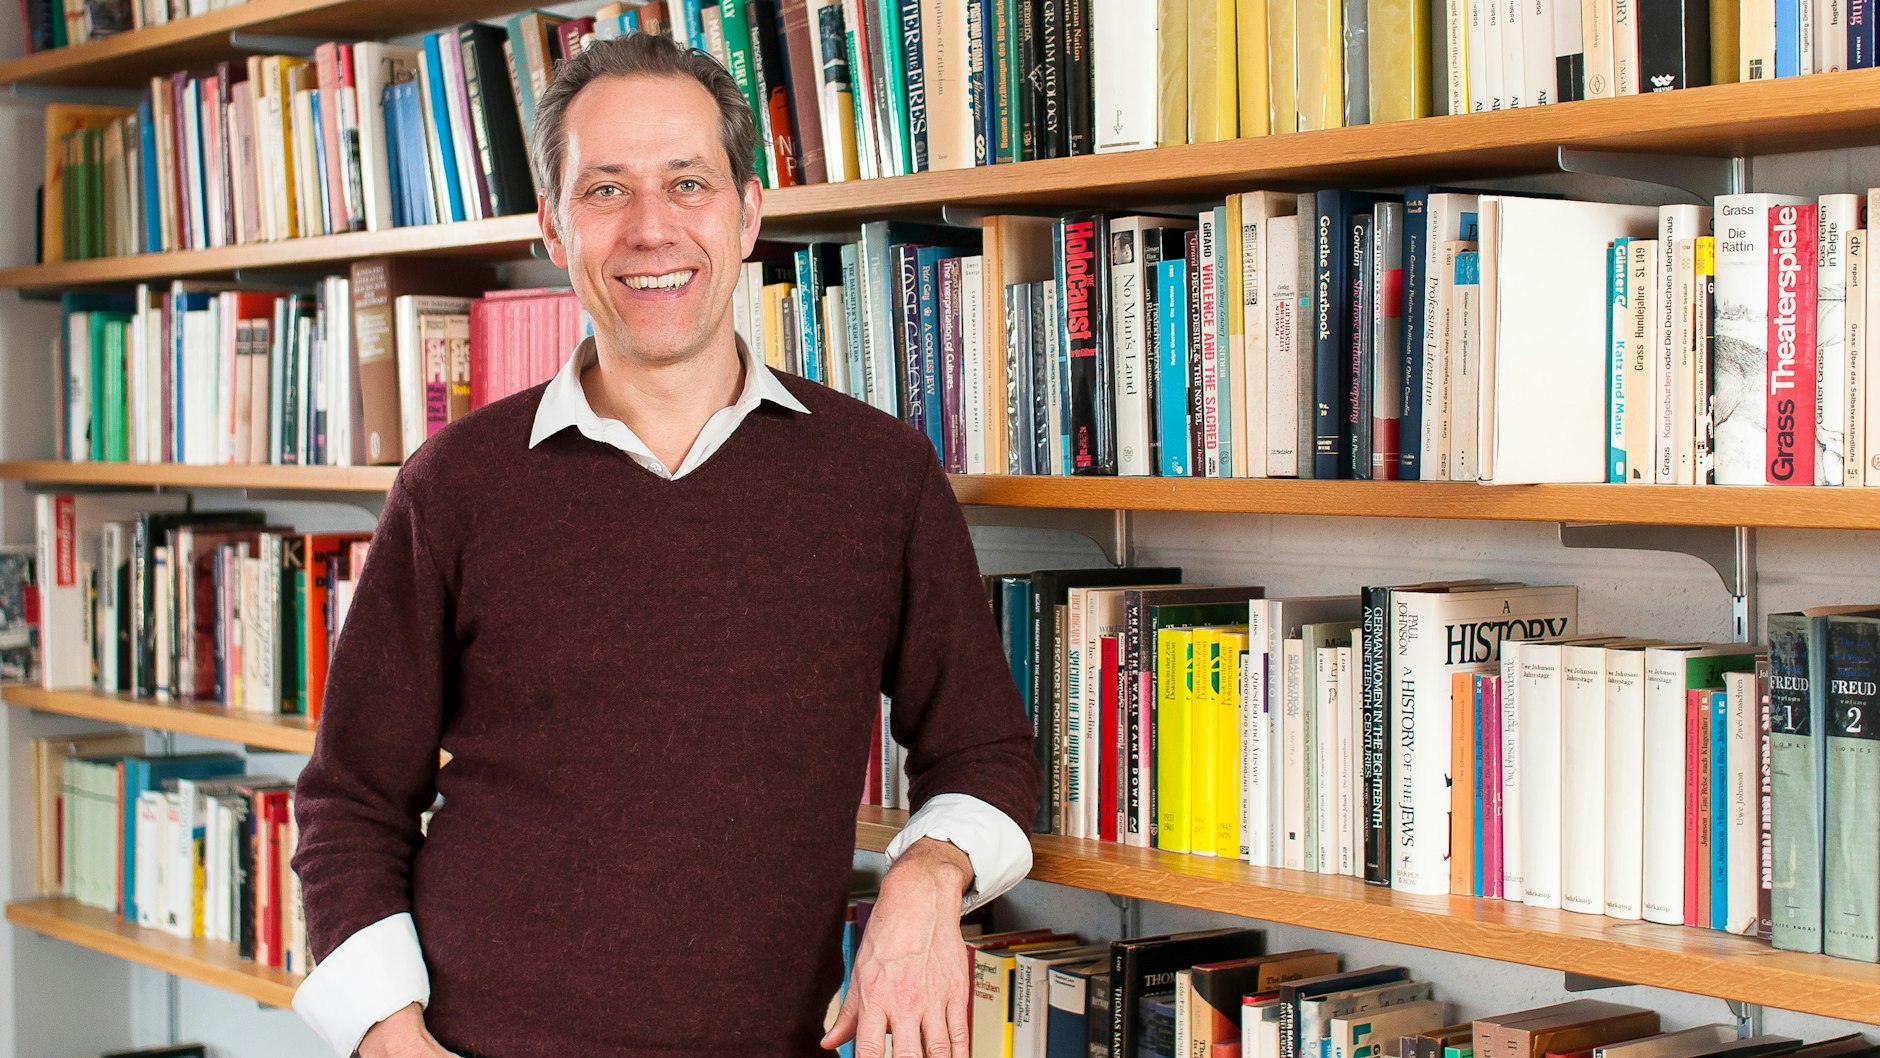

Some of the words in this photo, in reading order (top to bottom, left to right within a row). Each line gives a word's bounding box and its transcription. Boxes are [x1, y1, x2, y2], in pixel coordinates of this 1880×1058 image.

[751, 27, 764, 69] Nietzsche
[909, 45, 919, 70] THE
[732, 50, 747, 86] PURE
[755, 70, 765, 83] as
[1044, 1, 1057, 134] GRAMMATOLOGY
[907, 67, 926, 134] FIRES
[1431, 210, 1439, 238] GERALD
[1722, 205, 1754, 216] Grass
[1819, 205, 1827, 242] Treffen
[1319, 216, 1330, 268] Goethe
[1353, 225, 1364, 266] Gordon
[1722, 241, 1754, 252] Rättin
[1728, 228, 1746, 238] Die
[1827, 222, 1838, 255] Telgte
[1850, 237, 1861, 256] dtv
[1189, 238, 1198, 267] Girard
[1217, 255, 1225, 269] City
[1635, 247, 1646, 263] 149
[1665, 235, 1673, 272] sterben
[1818, 244, 1826, 267] Das
[1828, 257, 1837, 267] in
[944, 261, 953, 278] The
[1065, 221, 1095, 341] Holocaust
[1086, 274, 1095, 287] THE
[1123, 274, 1135, 297] No
[1218, 276, 1224, 284] of
[1635, 266, 1645, 278] SL
[1851, 263, 1859, 287] report
[849, 278, 857, 323] DAUGHTER'S
[1146, 288, 1152, 300] on
[1190, 272, 1200, 312] DECEIT,
[1319, 271, 1330, 340] Yearbook
[1352, 279, 1363, 299] She
[1665, 275, 1673, 328] Deutschen
[1771, 206, 1802, 395] Theaterspiele
[944, 280, 954, 340] Interpretation
[1146, 302, 1154, 336] Rhetoric
[1218, 311, 1226, 337] Literary
[1353, 301, 1363, 330] drove
[1424, 276, 1439, 339] Professing
[1635, 285, 1646, 338] Hundejahre
[924, 323, 932, 331] A
[1123, 302, 1136, 351] Man's
[1191, 314, 1201, 353] DESIRE,
[1664, 330, 1672, 346] Die
[925, 333, 934, 374] GODLESS
[944, 342, 954, 352] of
[1192, 353, 1202, 363] &
[1203, 332, 1215, 361] AND
[1352, 332, 1363, 375] without
[1635, 344, 1644, 371] Grass
[1664, 347, 1672, 370] oder
[1850, 351, 1860, 370] Über
[926, 375, 935, 396] JEW
[946, 354, 955, 389] Cultures
[972, 368, 980, 404] european
[1124, 355, 1137, 396] Land
[1146, 357, 1154, 399] Language
[1194, 365, 1202, 388] THE
[1204, 365, 1215, 391] THE
[1425, 343, 1437, 406] Literature
[1350, 376, 1362, 424] stopping
[1663, 371, 1672, 438] Kopfgeburten
[973, 407, 981, 433] poetry
[1205, 396, 1216, 449] SACRED
[1849, 387, 1857, 462] Selbstverständliche
[1771, 399, 1795, 481] Grass
[1662, 447, 1671, 476] Grass
[1364, 606, 1373, 632] AND
[1501, 599, 1511, 614] A
[1131, 607, 1139, 645] WHEN
[1373, 607, 1384, 659] GERMAN
[1397, 600, 1408, 656] JOHNSON
[1407, 614, 1419, 642] PAUL
[1087, 638, 1095, 659] The
[1131, 651, 1139, 675] THE
[1052, 637, 1061, 699] PISCATOR'S
[1087, 664, 1096, 680] Act
[1169, 641, 1177, 700] Dokumentation
[1226, 646, 1234, 706] Dokumentation
[1364, 635, 1373, 710] NINETEENTH
[1373, 661, 1384, 708] WOMEN
[1402, 666, 1413, 676] A
[1770, 676, 1809, 692] FREUD
[1087, 683, 1095, 695] of
[1131, 682, 1139, 716] WALL
[1251, 672, 1260, 719] Question
[1831, 679, 1877, 697] FREUD
[1052, 703, 1061, 755] POLITICAL
[1085, 698, 1095, 739] Reading
[1252, 721, 1260, 742] and
[1373, 710, 1384, 723] IN
[1401, 680, 1415, 752] HISTORY
[1716, 720, 1725, 745] Jakob
[1783, 706, 1796, 731] 1
[1846, 707, 1862, 733] 2
[1131, 724, 1139, 759] CAME
[1364, 713, 1372, 778] CENTURIES
[1372, 725, 1384, 750] THE
[1701, 717, 1709, 755] Klagenfurt
[1252, 743, 1260, 786] Answer
[1402, 753, 1413, 771] OF
[1716, 746, 1725, 765] über
[1052, 759, 1061, 807] THEATRE
[1131, 767, 1139, 807] DOWN
[1372, 752, 1383, 829] EIGHTEENTH
[1402, 775, 1413, 803] THE
[1717, 766, 1726, 826] Mutmassungen
[1736, 772, 1745, 805] Johnson
[1398, 803, 1415, 847] JEWS
[1701, 817, 1709, 847] Johnson
[1736, 806, 1744, 826] Uwe
[1717, 830, 1725, 864] Johnson
[1717, 865, 1725, 883] Uwe
[1114, 987, 1122, 1030] THOMAS
